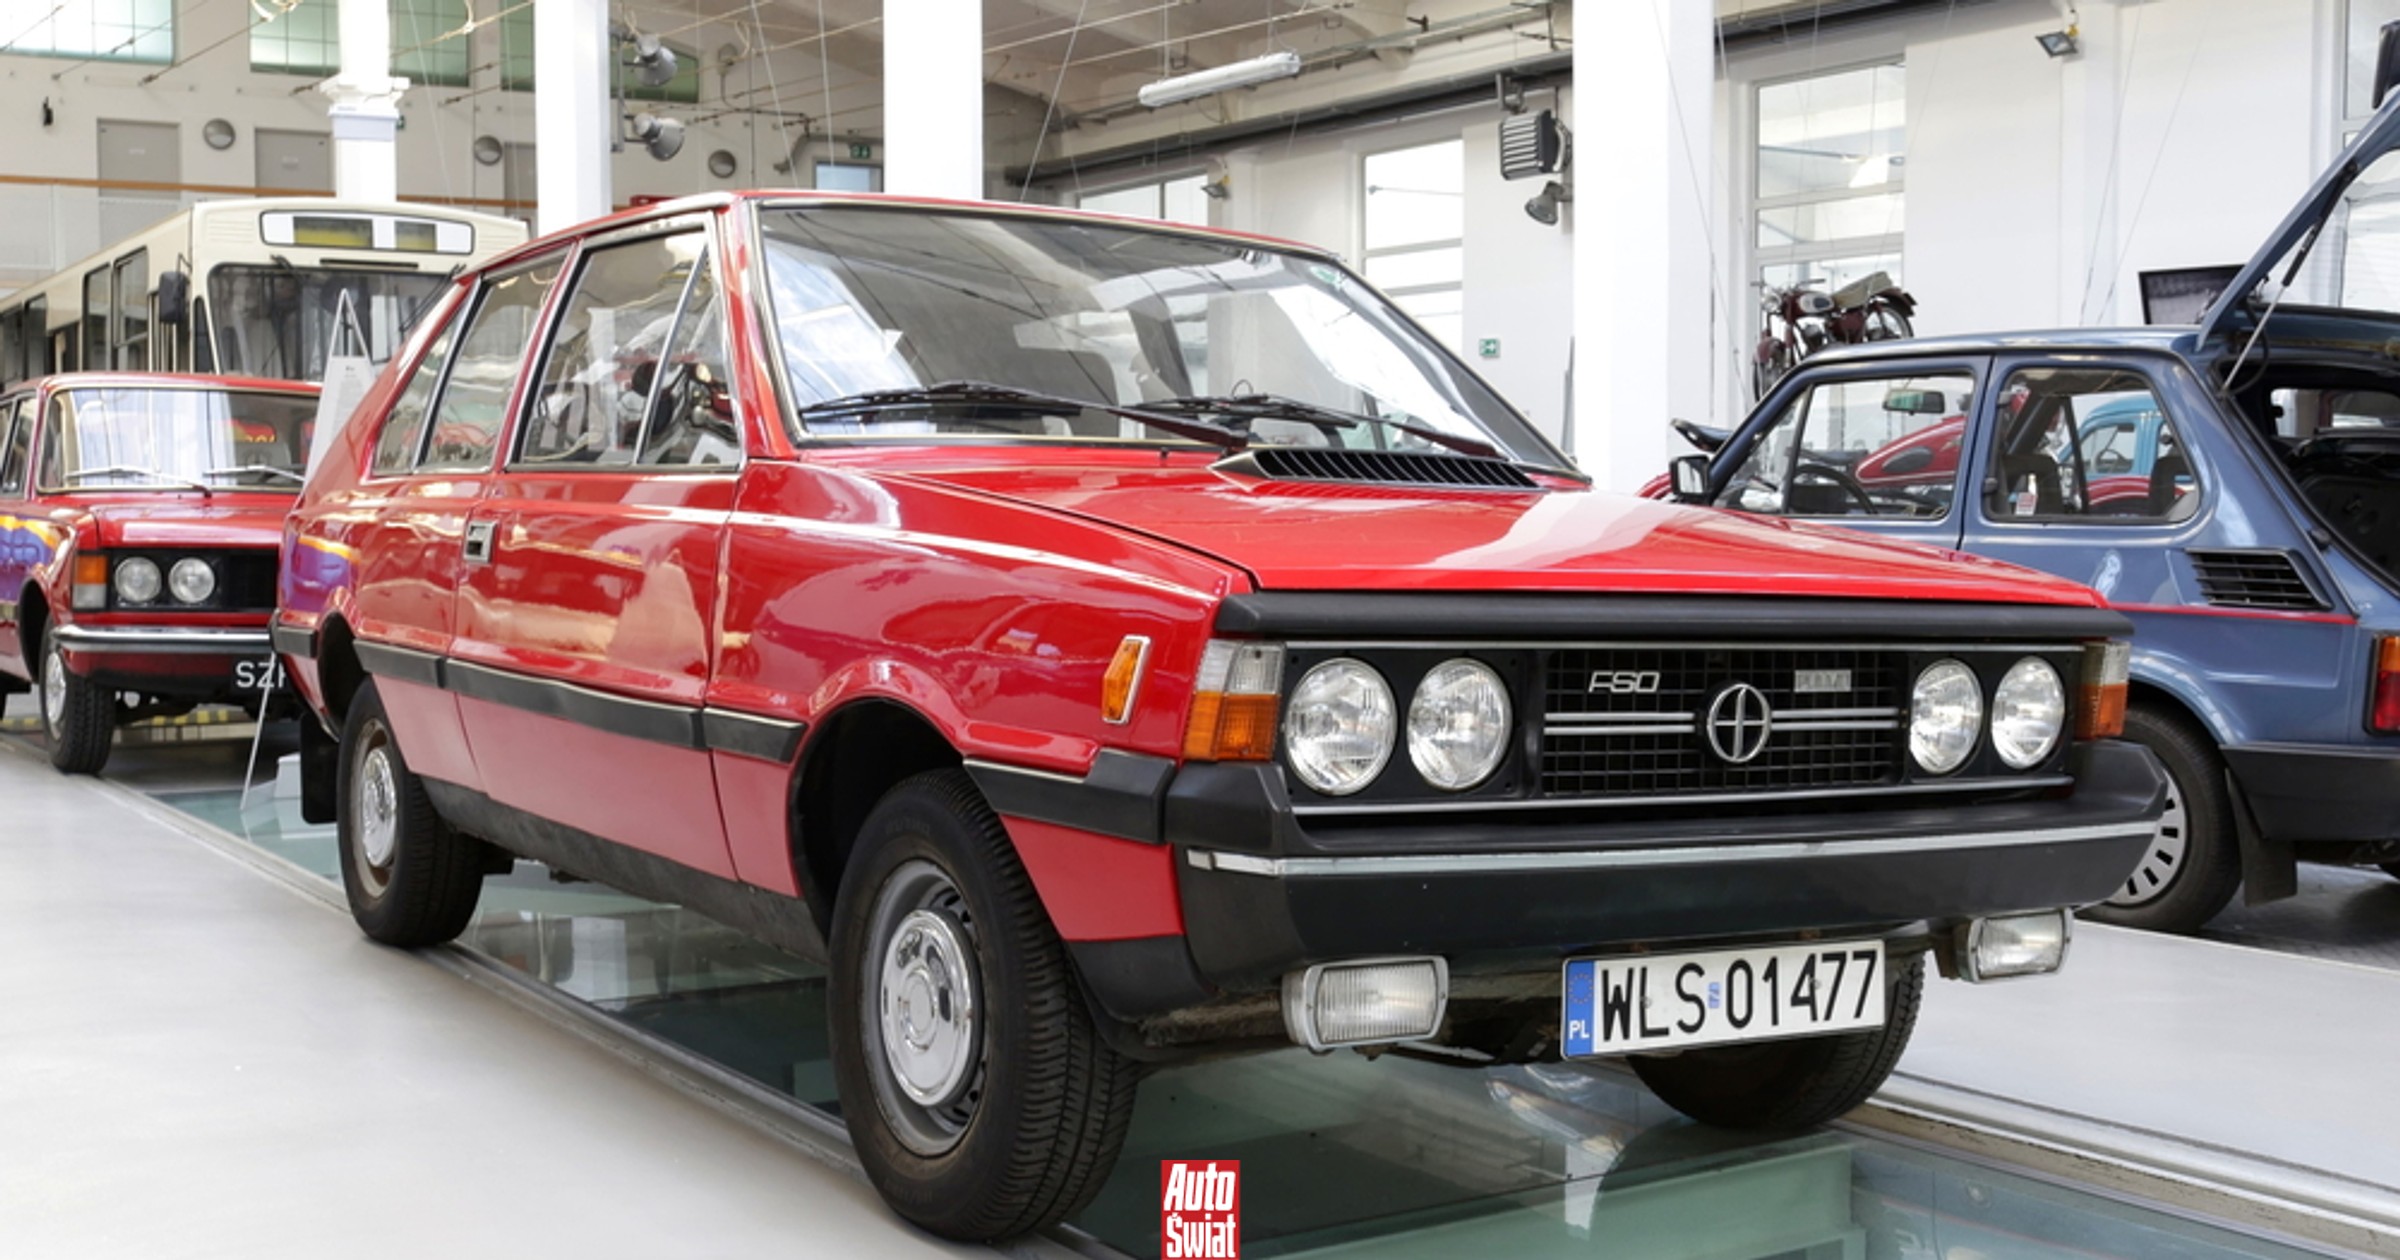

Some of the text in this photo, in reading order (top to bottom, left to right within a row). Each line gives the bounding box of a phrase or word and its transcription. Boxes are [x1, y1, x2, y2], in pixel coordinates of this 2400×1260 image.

[1588, 671, 1660, 693] FSO
[1602, 949, 1878, 1042] WLS 01477
[1568, 1020, 1590, 1040] PL
